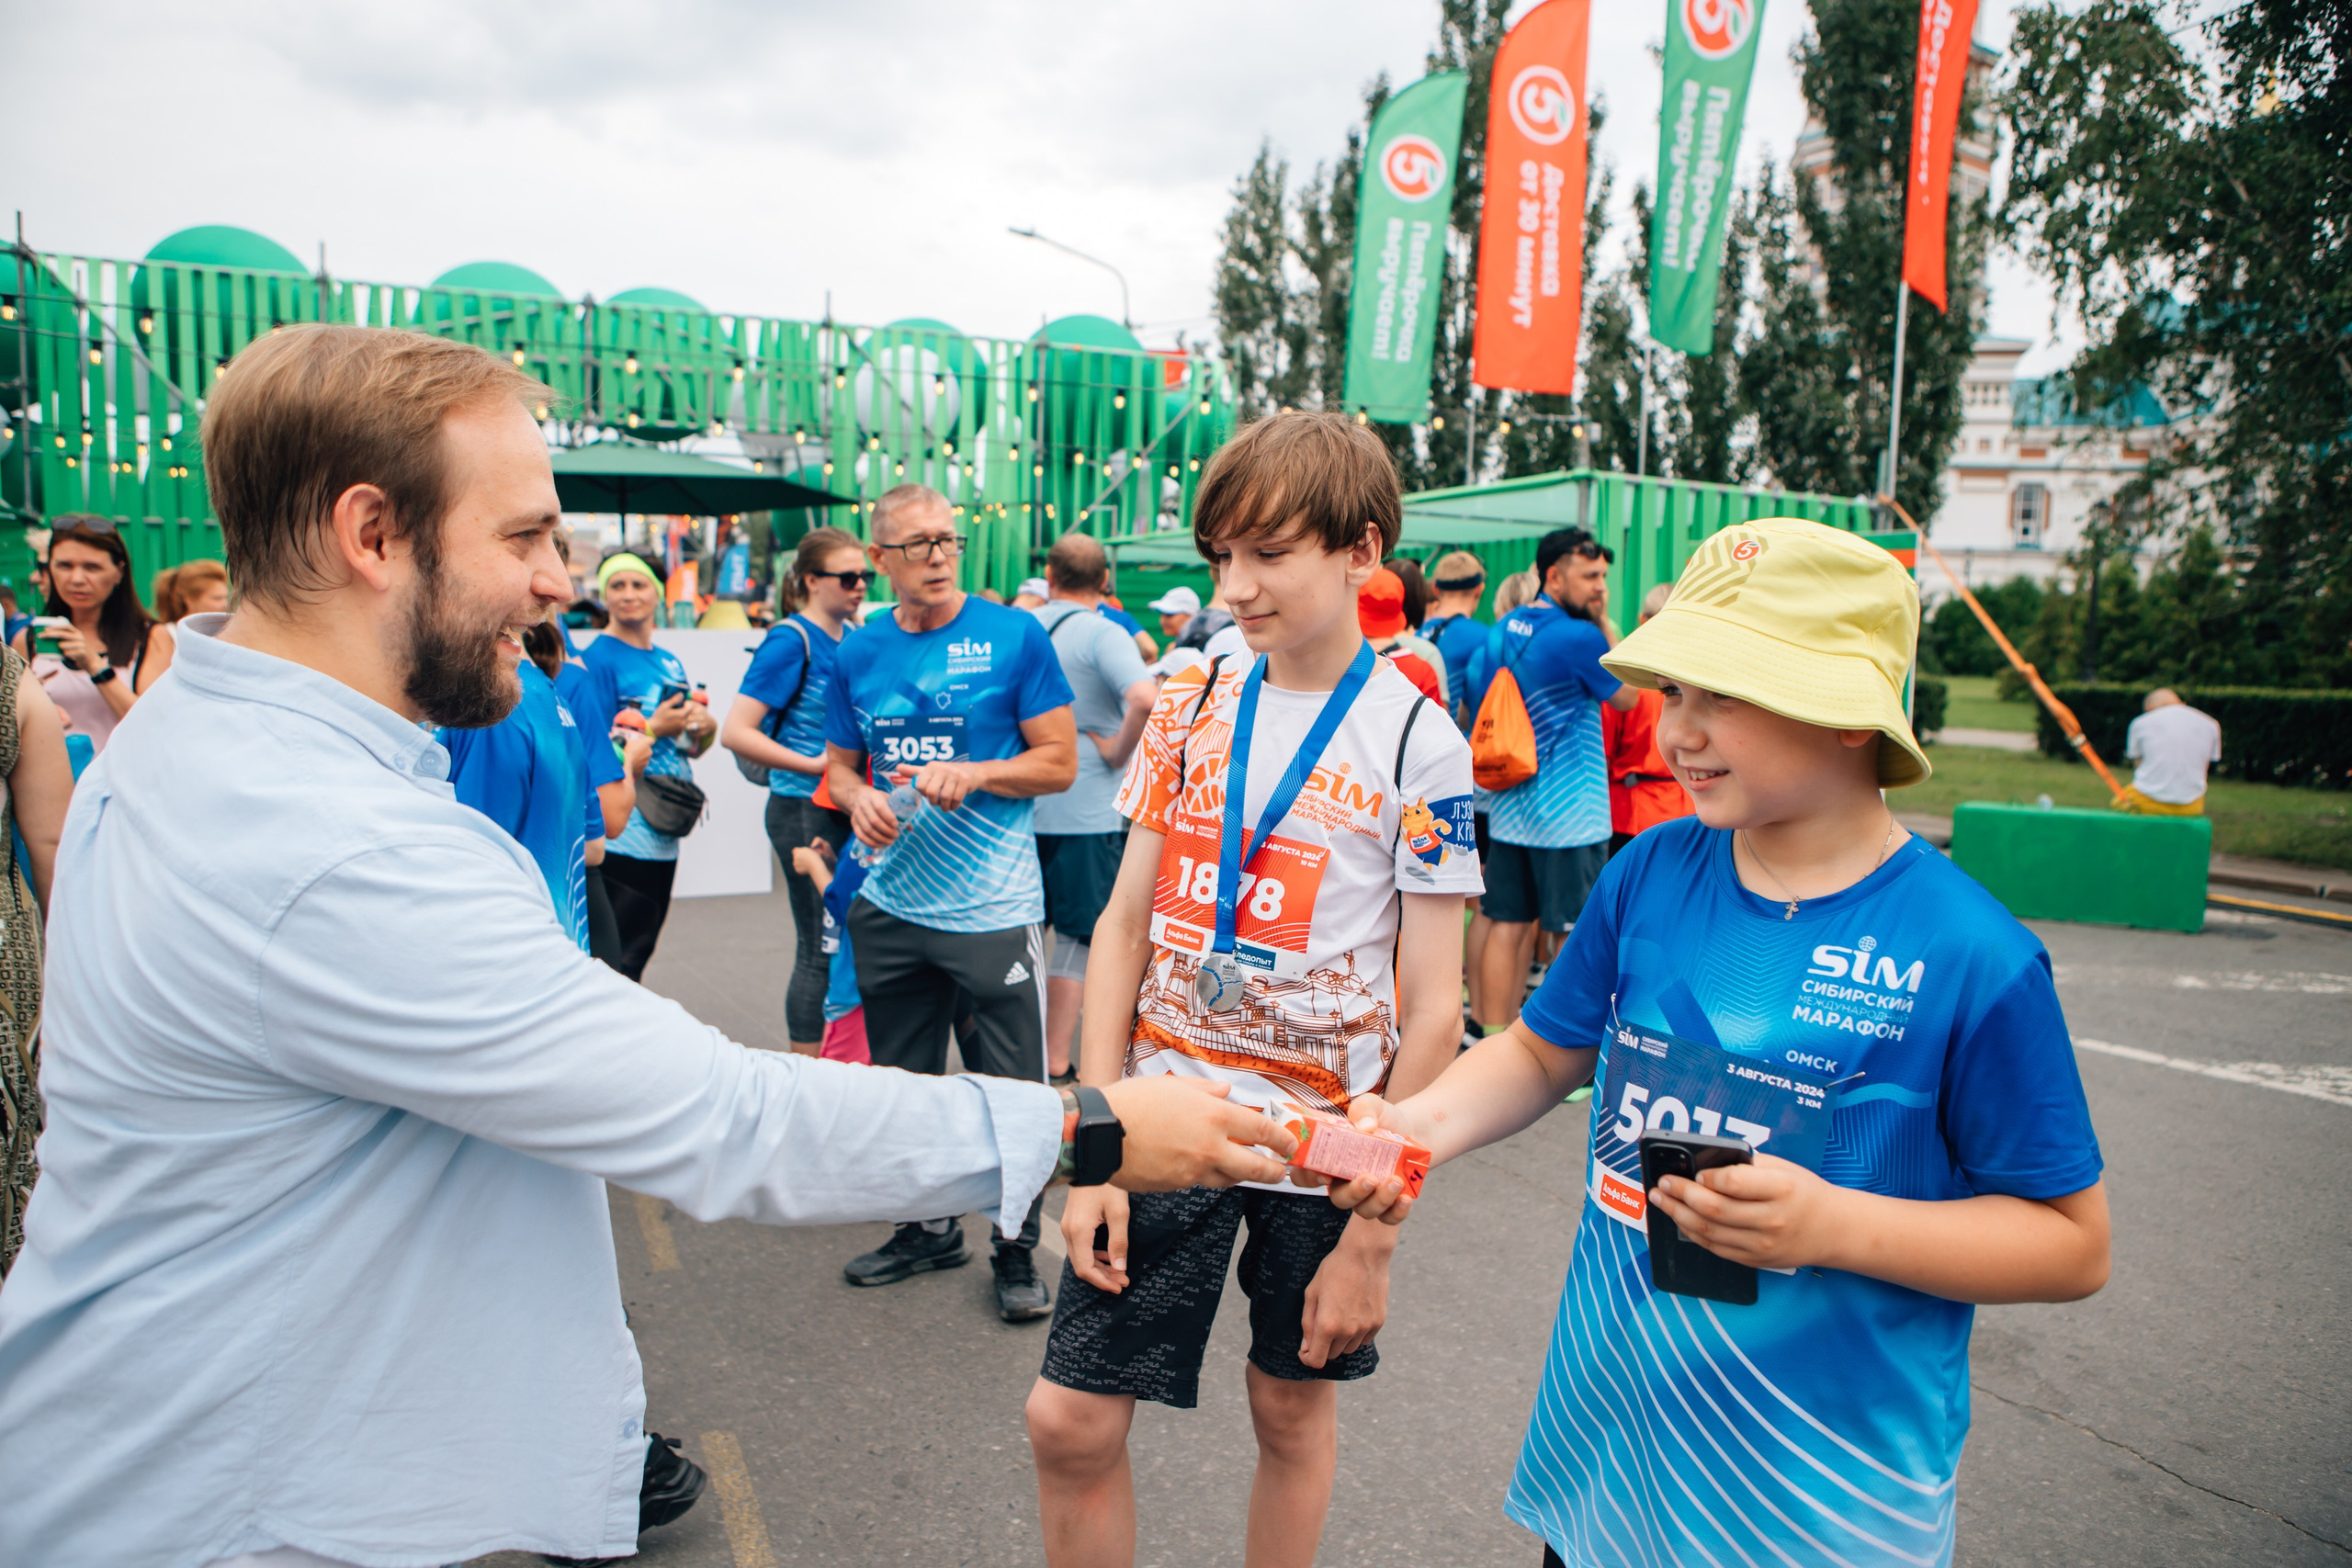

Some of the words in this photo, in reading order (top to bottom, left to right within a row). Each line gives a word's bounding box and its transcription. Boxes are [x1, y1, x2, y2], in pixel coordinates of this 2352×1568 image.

[1519, 160, 1539, 196] от
[1661, 78, 1701, 268] выручает!
[1518, 197, 1541, 233] 30
[1540, 162, 1565, 297] Доставка
[1371, 216, 1405, 361] выручает!
[1394, 220, 1432, 363] Пятёрочка
[1509, 236, 1535, 330] минут
[883, 736, 955, 762] 3053
[1267, 843, 1301, 857] АВГУСТА
[1301, 851, 1321, 862] 2024
[1166, 929, 1183, 940] Альфа
[1183, 933, 1201, 944] Банк
[1798, 995, 1909, 1025] МЕЖДУНАРОДНЫЙ
[1802, 979, 1915, 1013] СИБИРСКИЙ
[1792, 1004, 1905, 1042] МАРАФОН
[1639, 1045, 1667, 1059] МАРАФОН
[1785, 1050, 1838, 1074] ОМСК
[1726, 1063, 1736, 1074] 3
[1736, 1066, 1792, 1091] АВГУСТА
[1792, 1081, 1826, 1099] 2024
[1795, 1095, 1804, 1105] 3
[1804, 1098, 1823, 1110] КМ
[1602, 1181, 1621, 1202] Альфа
[1620, 1190, 1641, 1211] Банк
